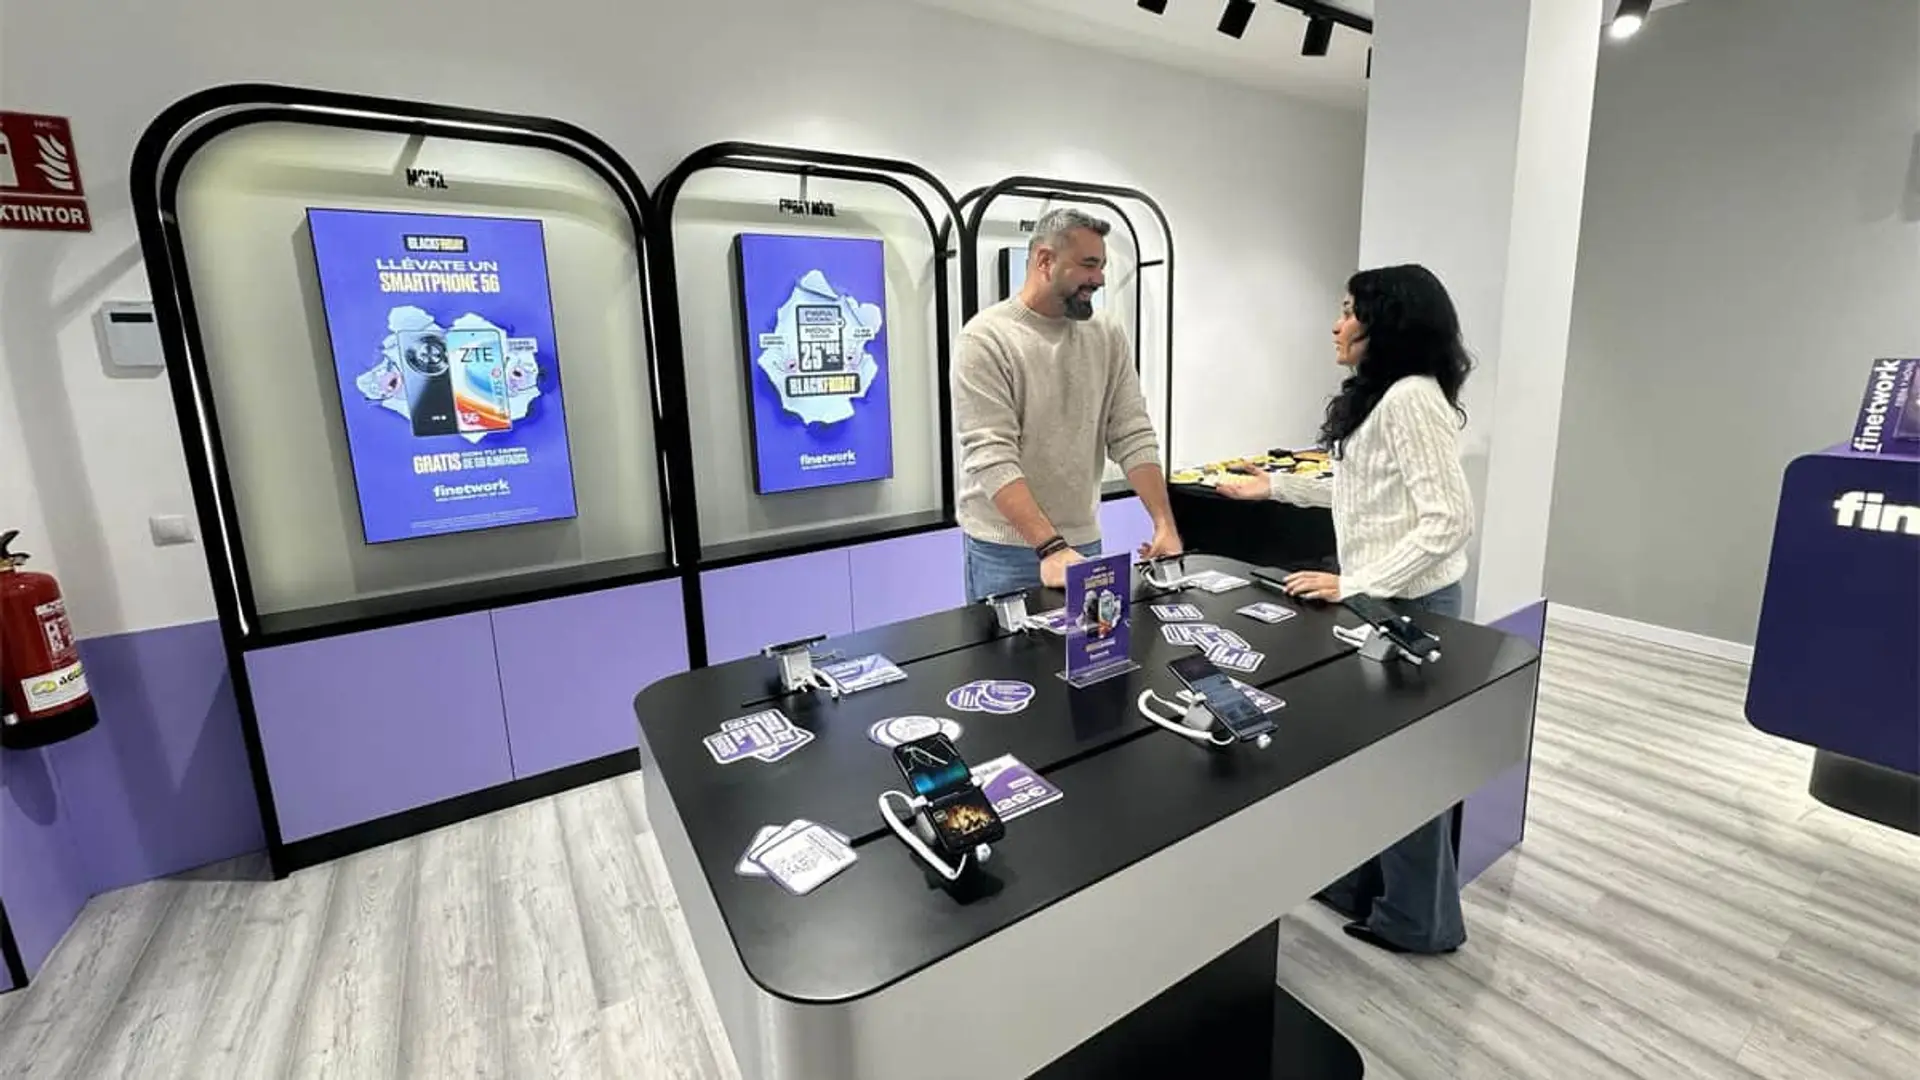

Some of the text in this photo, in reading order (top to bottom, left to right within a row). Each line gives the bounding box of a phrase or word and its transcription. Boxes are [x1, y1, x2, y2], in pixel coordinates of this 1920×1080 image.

[375, 257, 499, 272] LLÉVATE UN
[379, 270, 501, 293] SMARTPHONE 5G
[460, 346, 495, 363] ZTE
[1853, 360, 1901, 452] finetwork
[413, 452, 462, 474] GRATIS
[432, 478, 510, 499] finetwork
